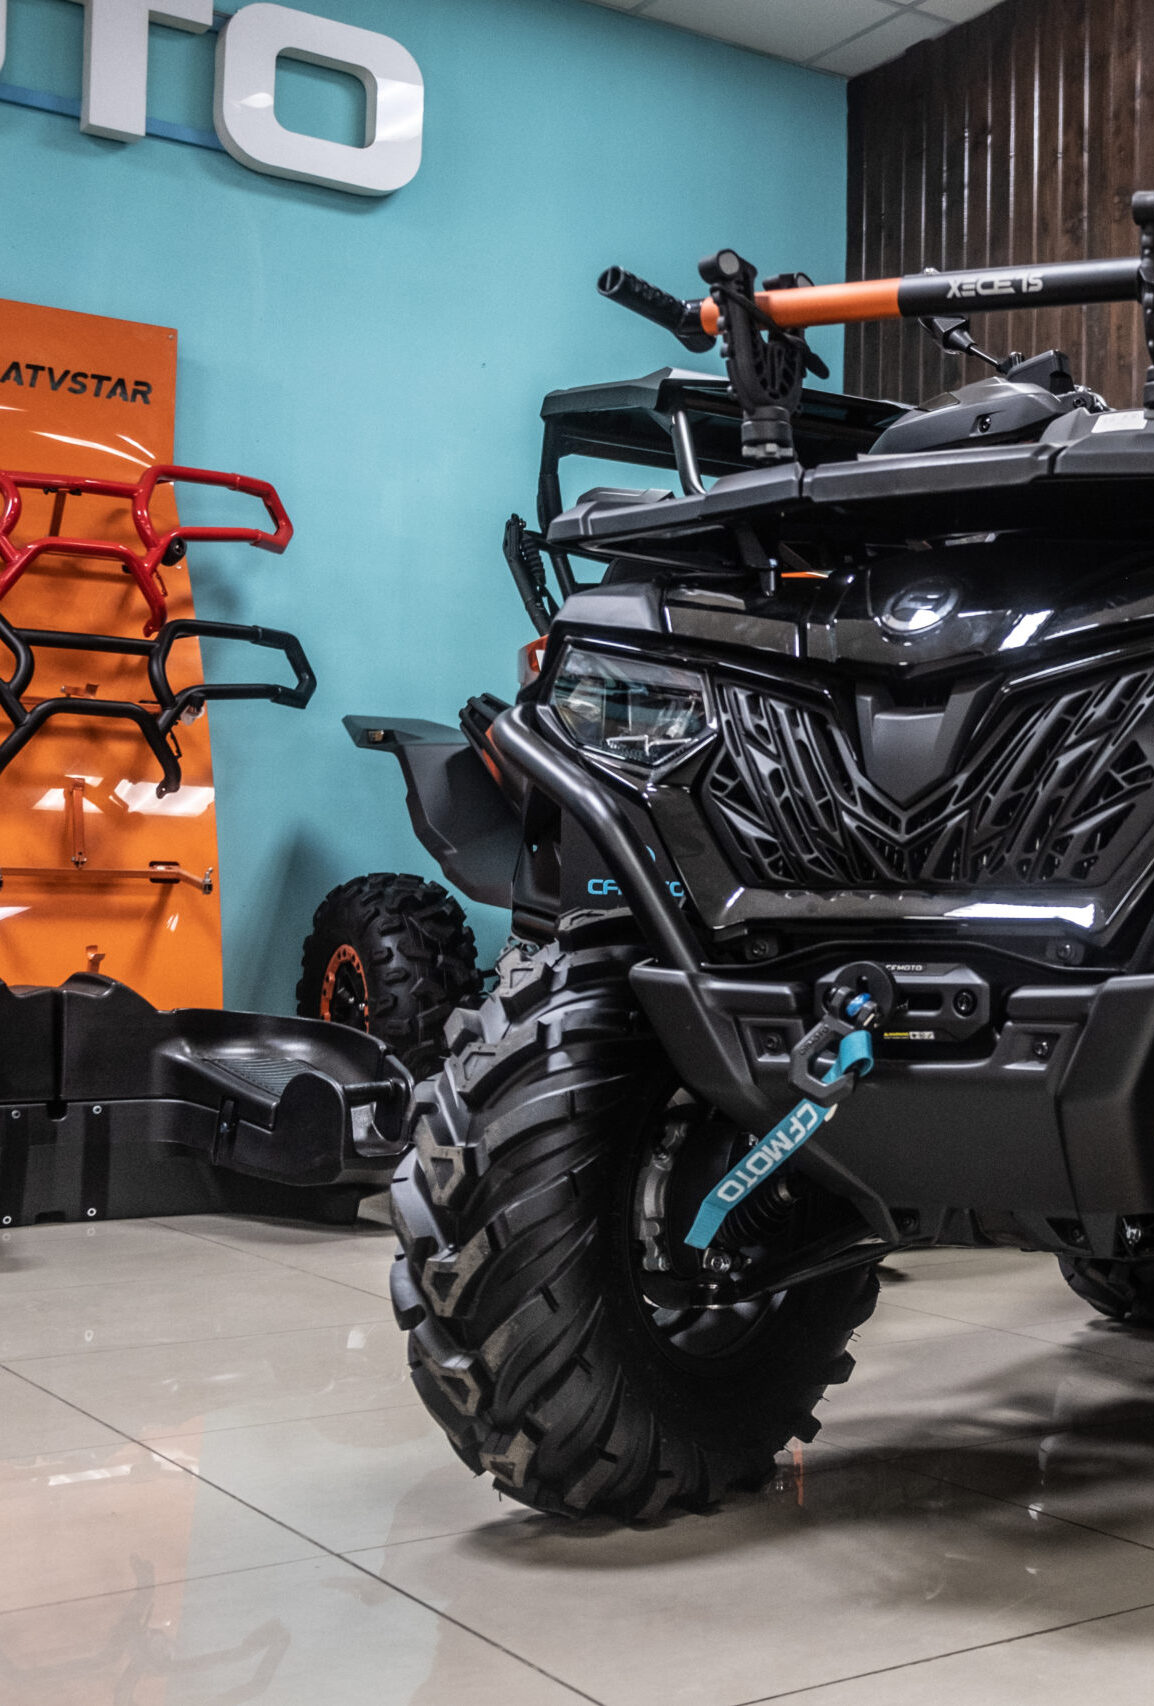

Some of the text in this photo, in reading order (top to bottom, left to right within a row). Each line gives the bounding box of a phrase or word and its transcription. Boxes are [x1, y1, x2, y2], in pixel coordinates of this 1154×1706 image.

[0, 0, 424, 196] TO
[0, 361, 153, 405] ATVSTAR
[717, 1103, 818, 1202] CFMOTO
